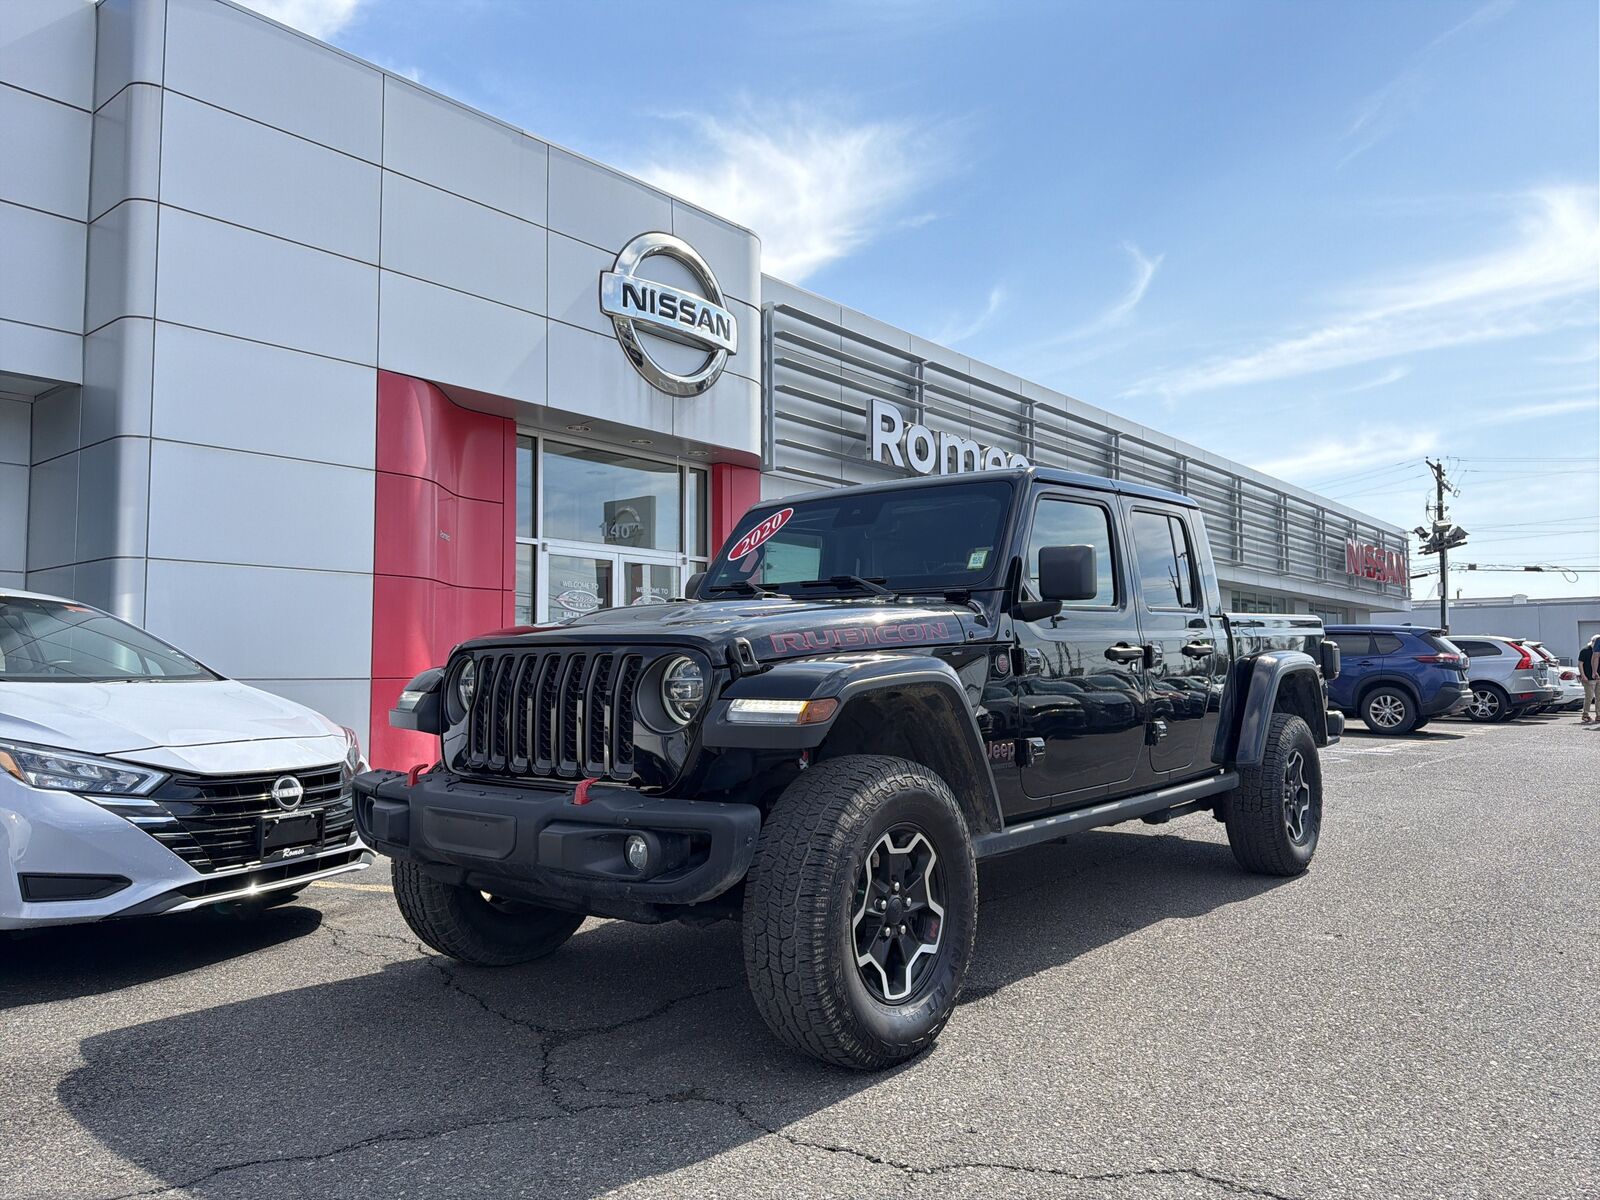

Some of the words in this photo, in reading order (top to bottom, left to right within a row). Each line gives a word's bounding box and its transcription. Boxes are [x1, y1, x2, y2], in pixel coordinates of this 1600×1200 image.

[622, 282, 731, 341] NISSAN
[740, 513, 782, 554] 2020
[1346, 538, 1407, 589] NISSAN
[562, 580, 590, 590] WELCOME
[769, 622, 950, 653] RUBICON
[988, 740, 1015, 761] Jeep
[271, 786, 304, 799] NISSAN
[282, 847, 305, 858] Romeo
